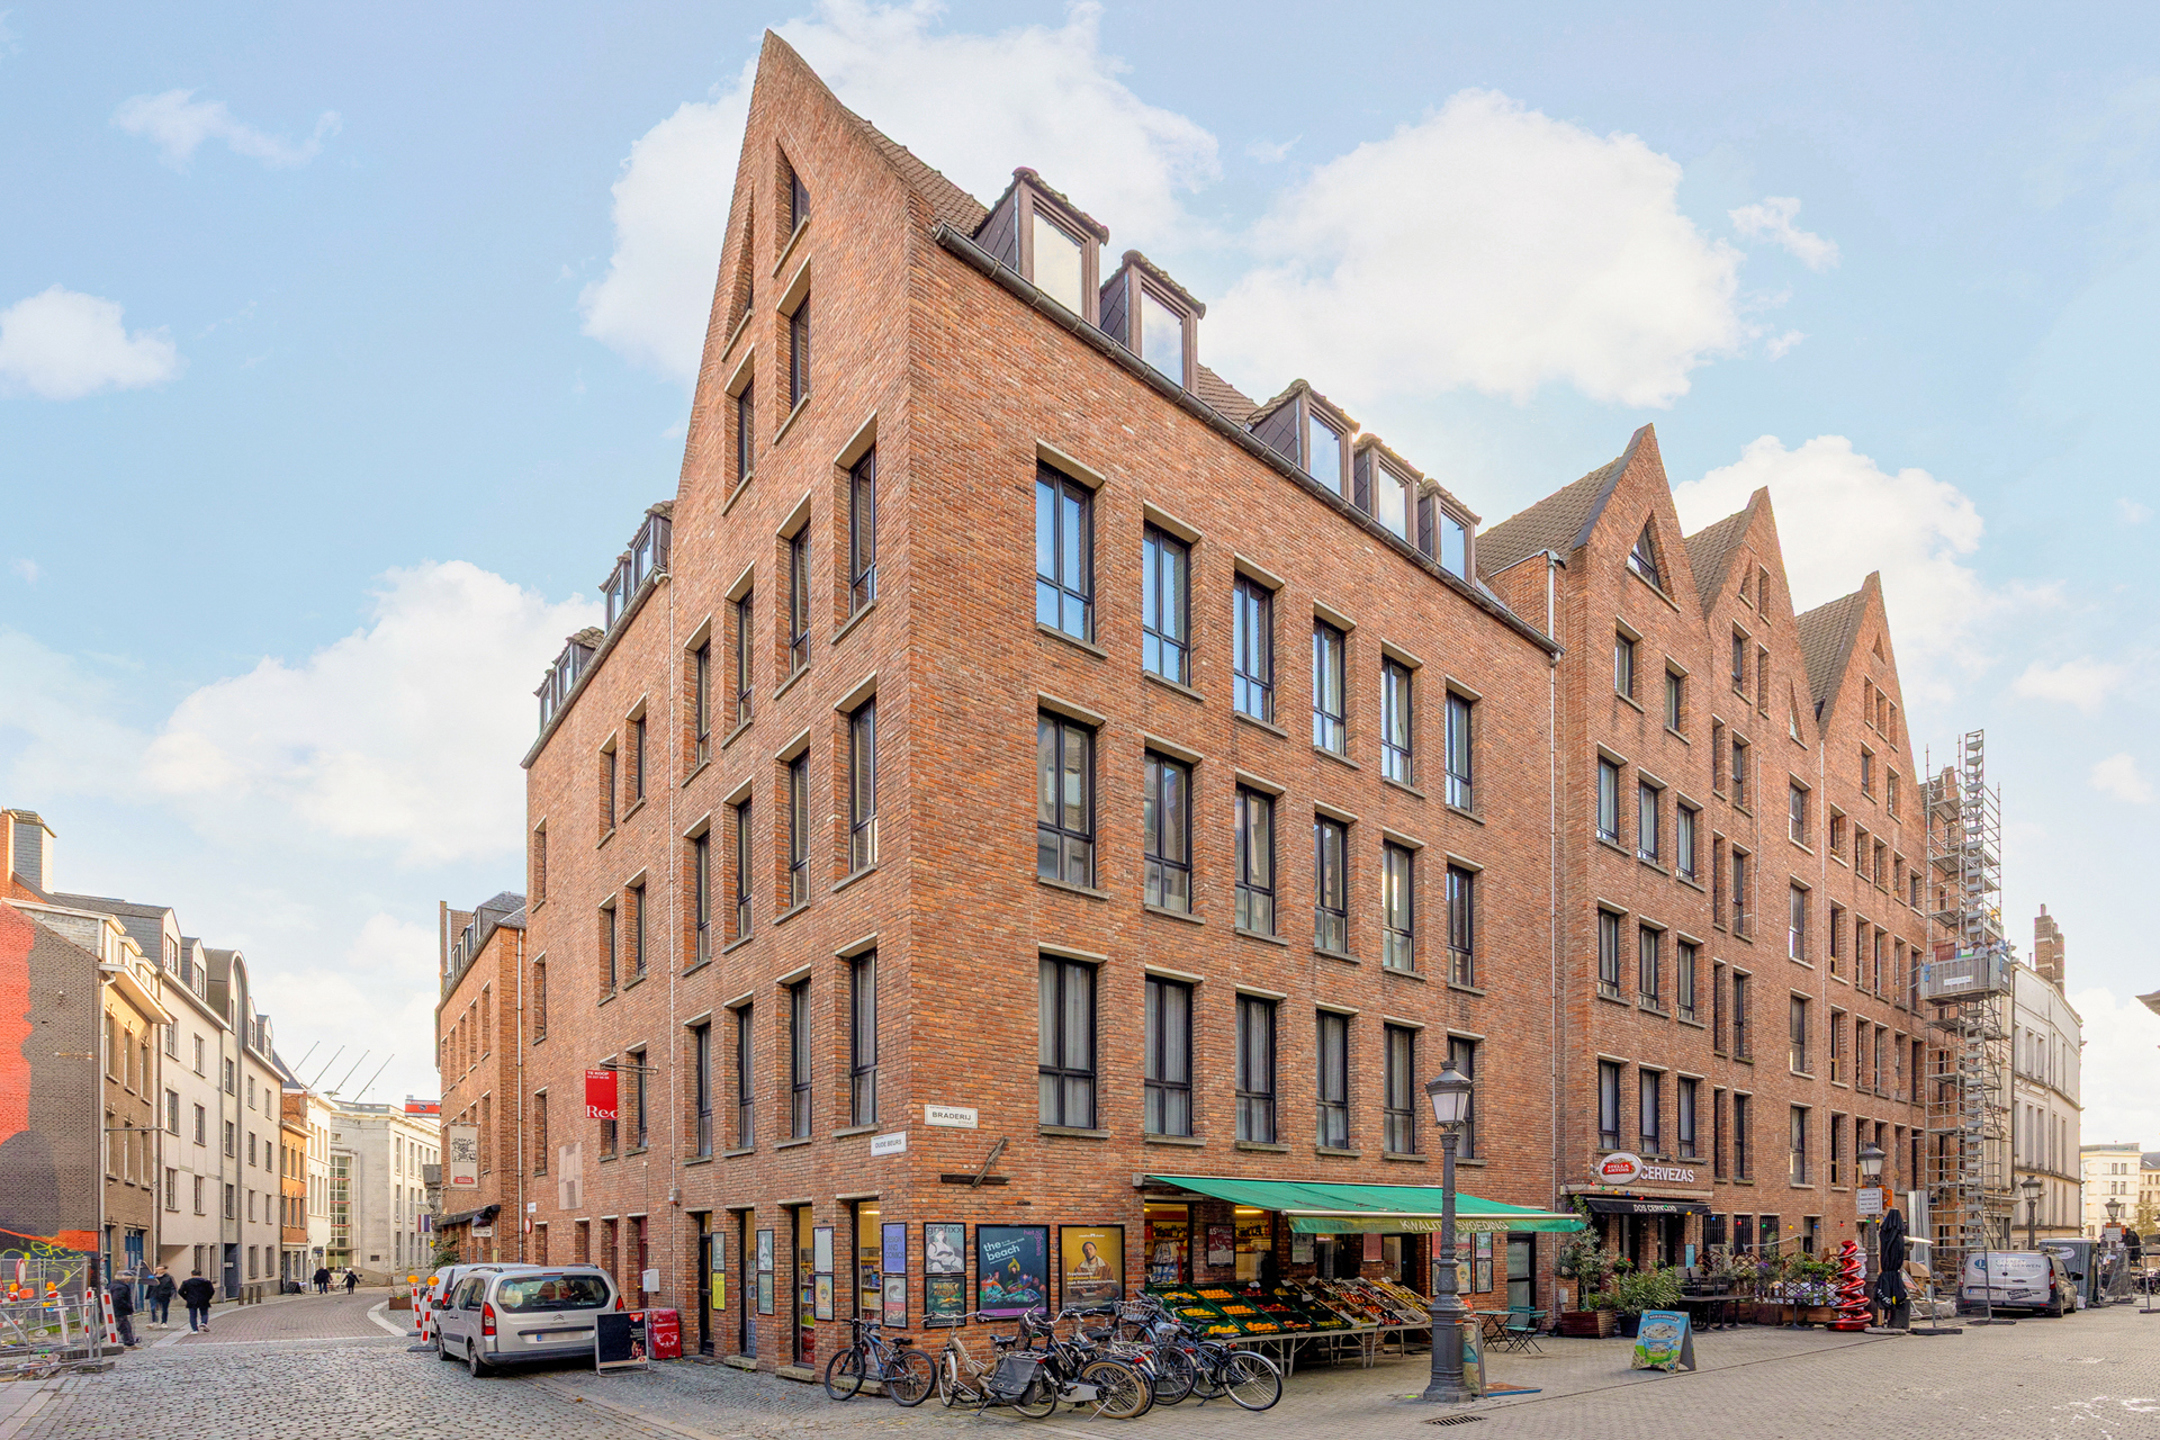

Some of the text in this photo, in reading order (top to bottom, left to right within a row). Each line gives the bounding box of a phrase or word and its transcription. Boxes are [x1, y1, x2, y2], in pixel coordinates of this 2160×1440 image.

[932, 1111, 972, 1121] BRADERIJ
[874, 1141, 887, 1149] OUDE
[887, 1138, 902, 1147] BEURS
[1640, 1165, 1694, 1183] CERVEZAS
[1633, 1204, 1647, 1212] DOS
[983, 1241, 1002, 1252] the
[986, 1244, 1020, 1261] beach
